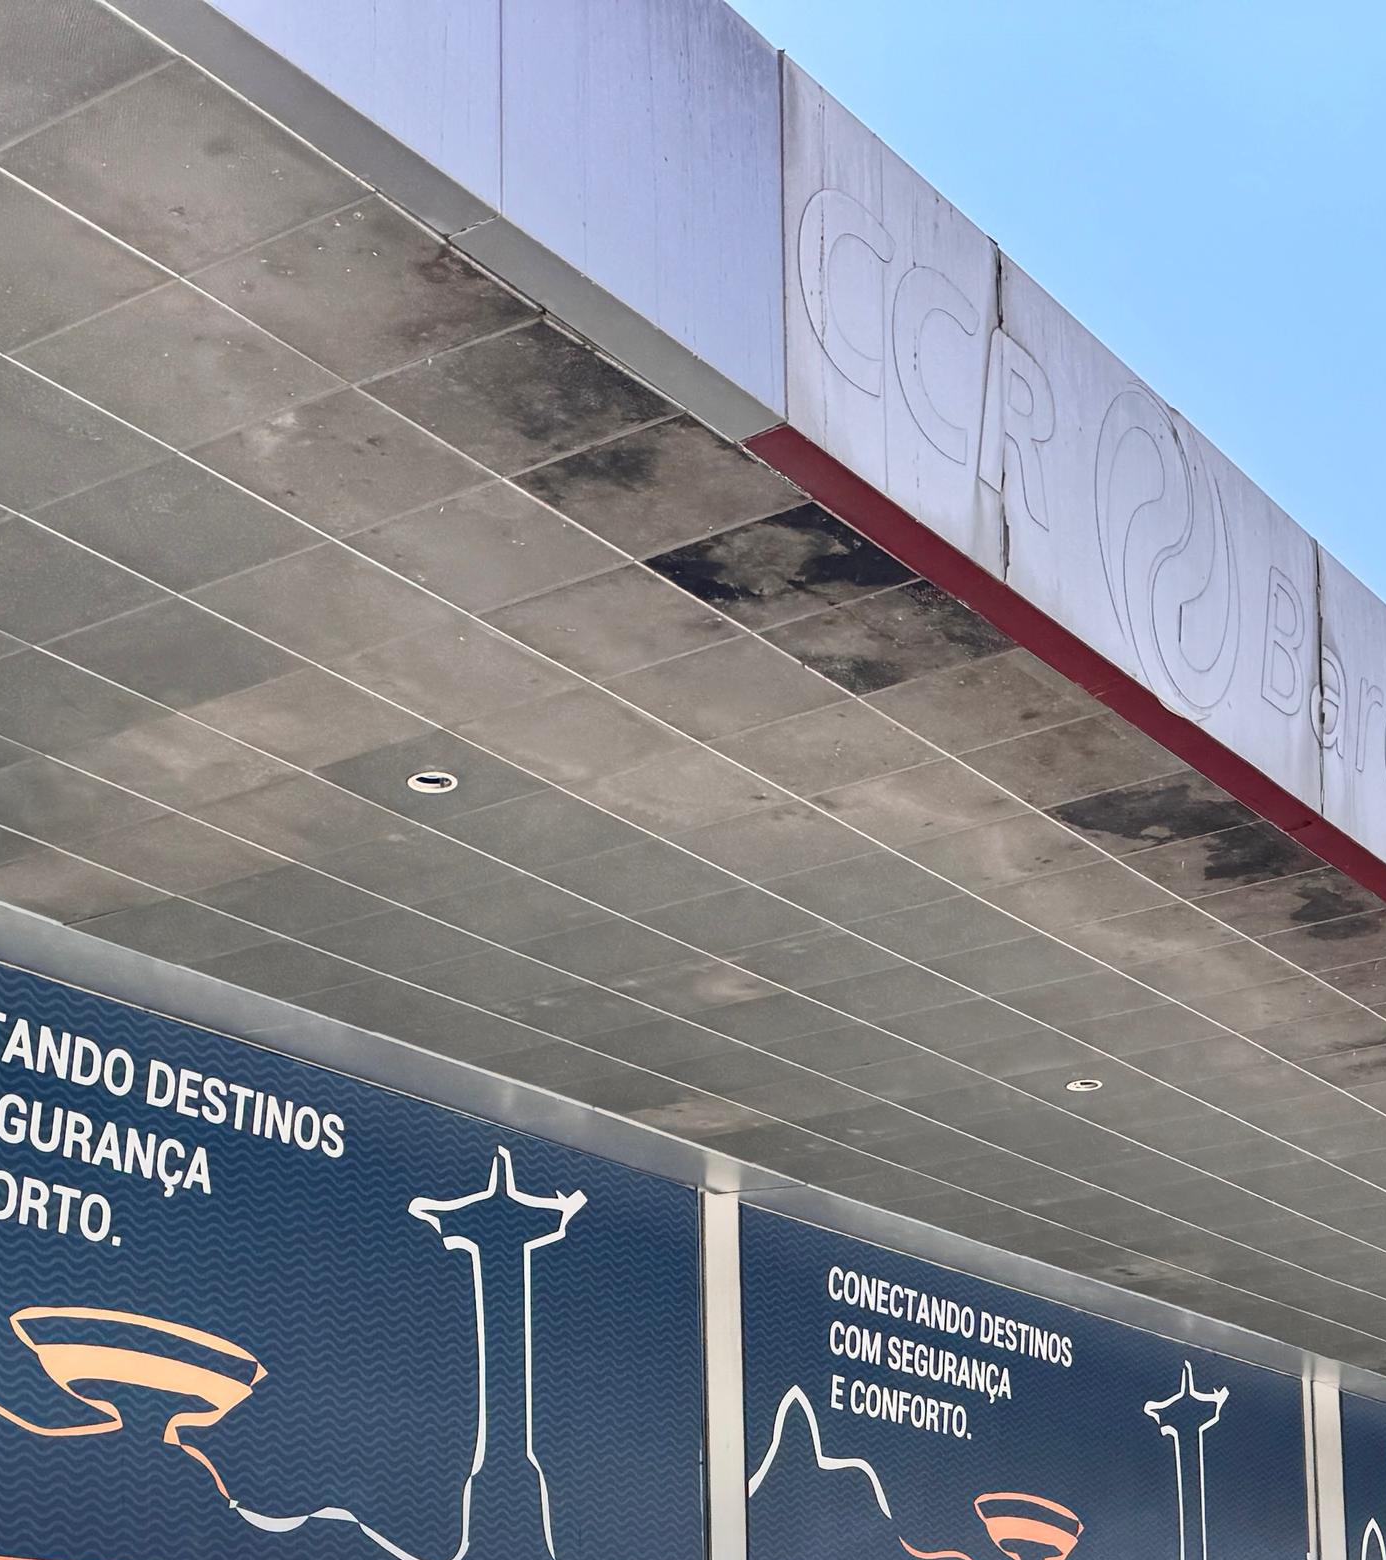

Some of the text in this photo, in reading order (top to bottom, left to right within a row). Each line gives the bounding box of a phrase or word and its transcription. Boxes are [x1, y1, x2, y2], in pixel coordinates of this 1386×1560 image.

[146, 1060, 345, 1159] DESTINOS
[828, 1266, 1073, 1368] CONECTANDO DESTINOS
[829, 1321, 1012, 1403] COM SEGURANÇA
[830, 1374, 972, 1440] E CONFORTO.
